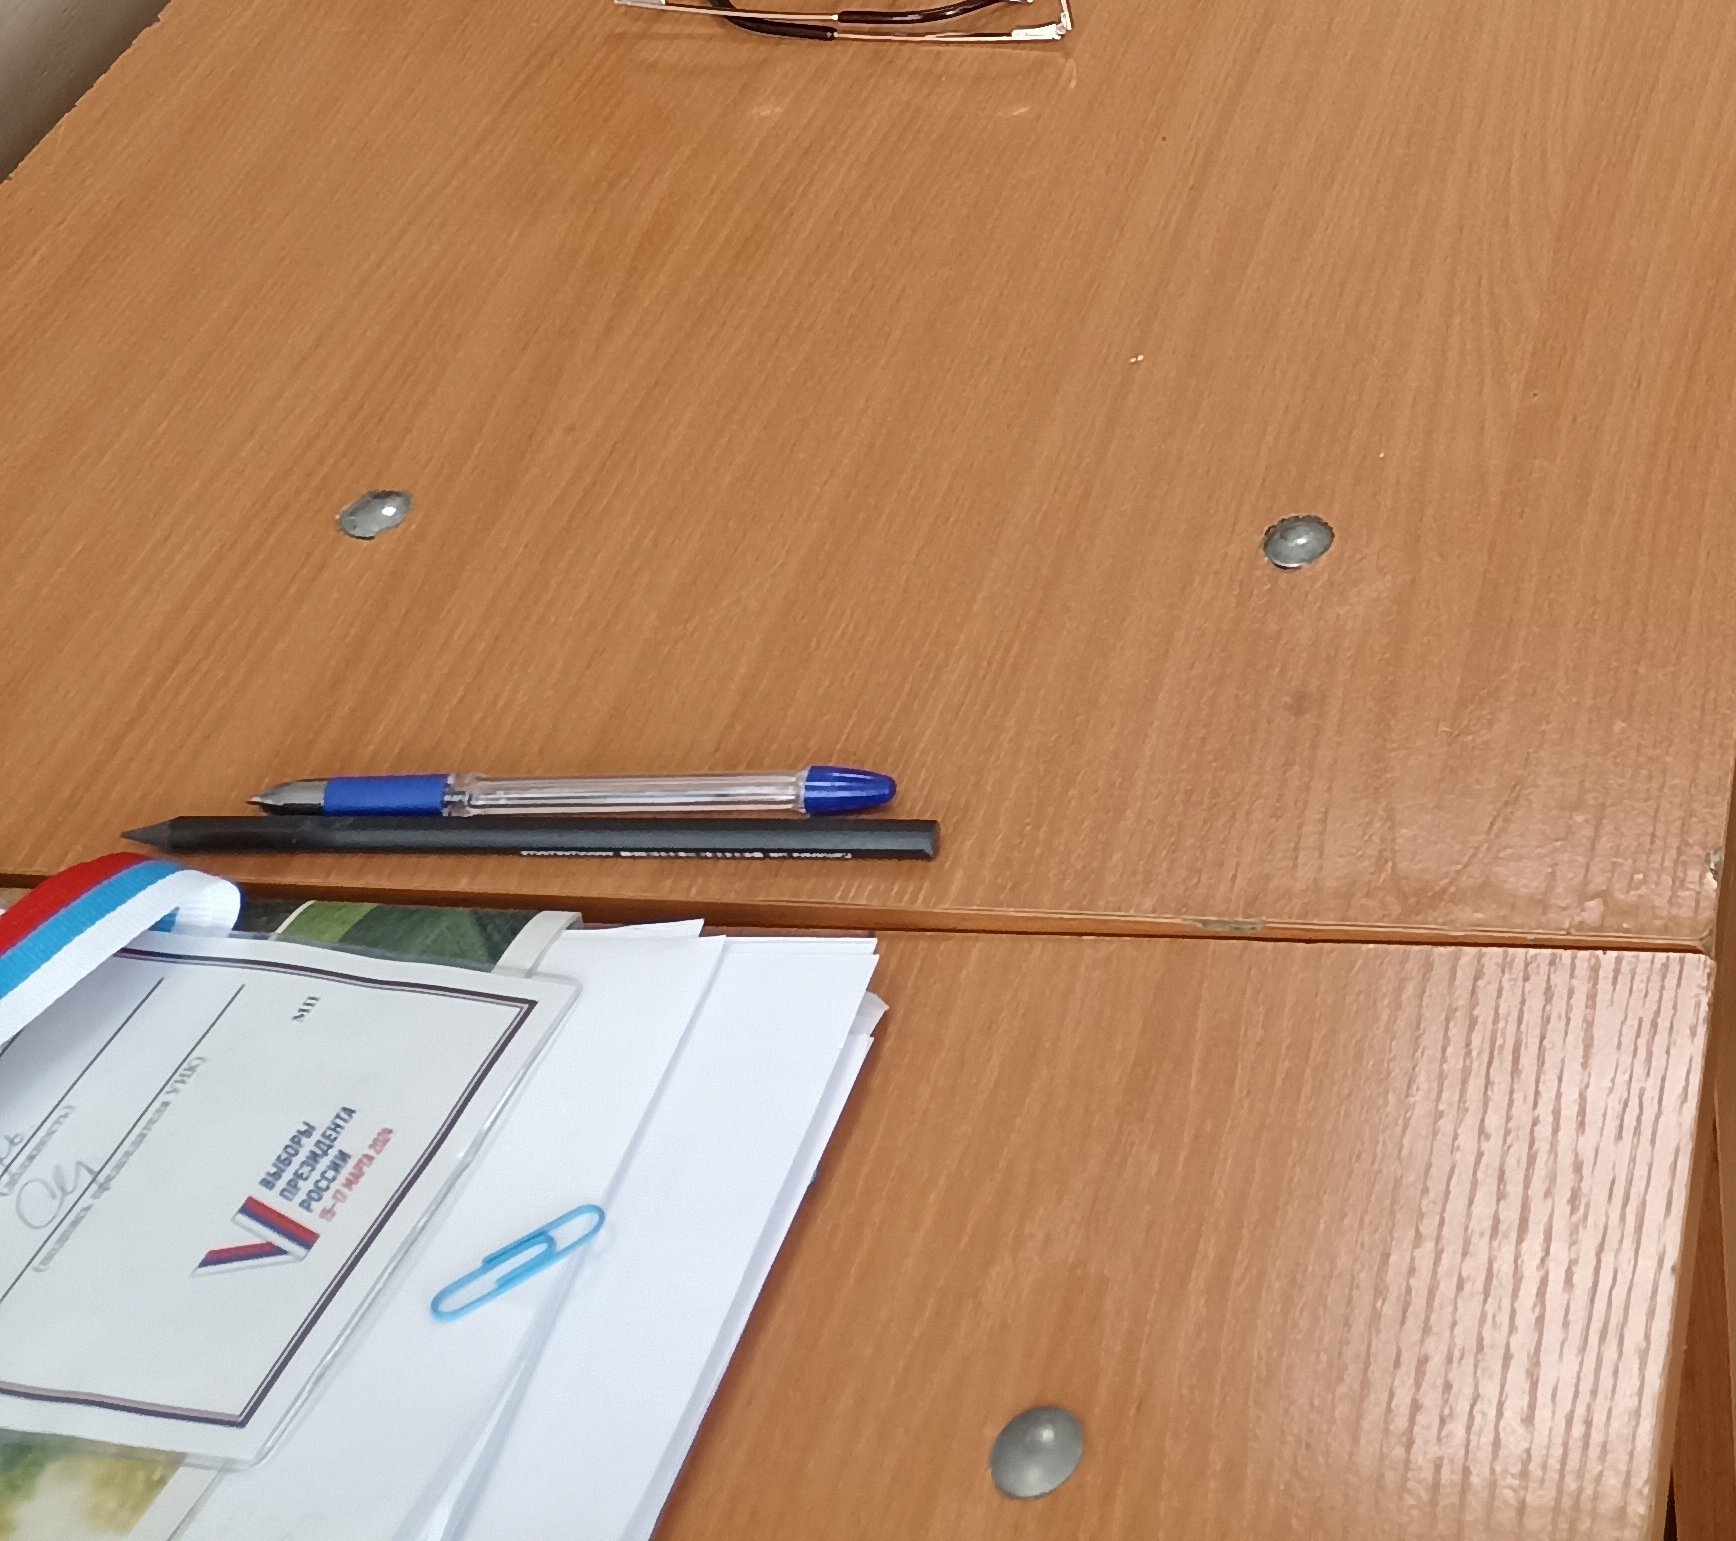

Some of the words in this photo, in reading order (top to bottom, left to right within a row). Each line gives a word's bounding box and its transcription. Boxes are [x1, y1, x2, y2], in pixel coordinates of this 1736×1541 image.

[259, 1120, 317, 1192] ВЫБОРЫ
[279, 1106, 358, 1202] ПРЕЗИДЕНТА
[298, 1148, 353, 1214] РОССИИ
